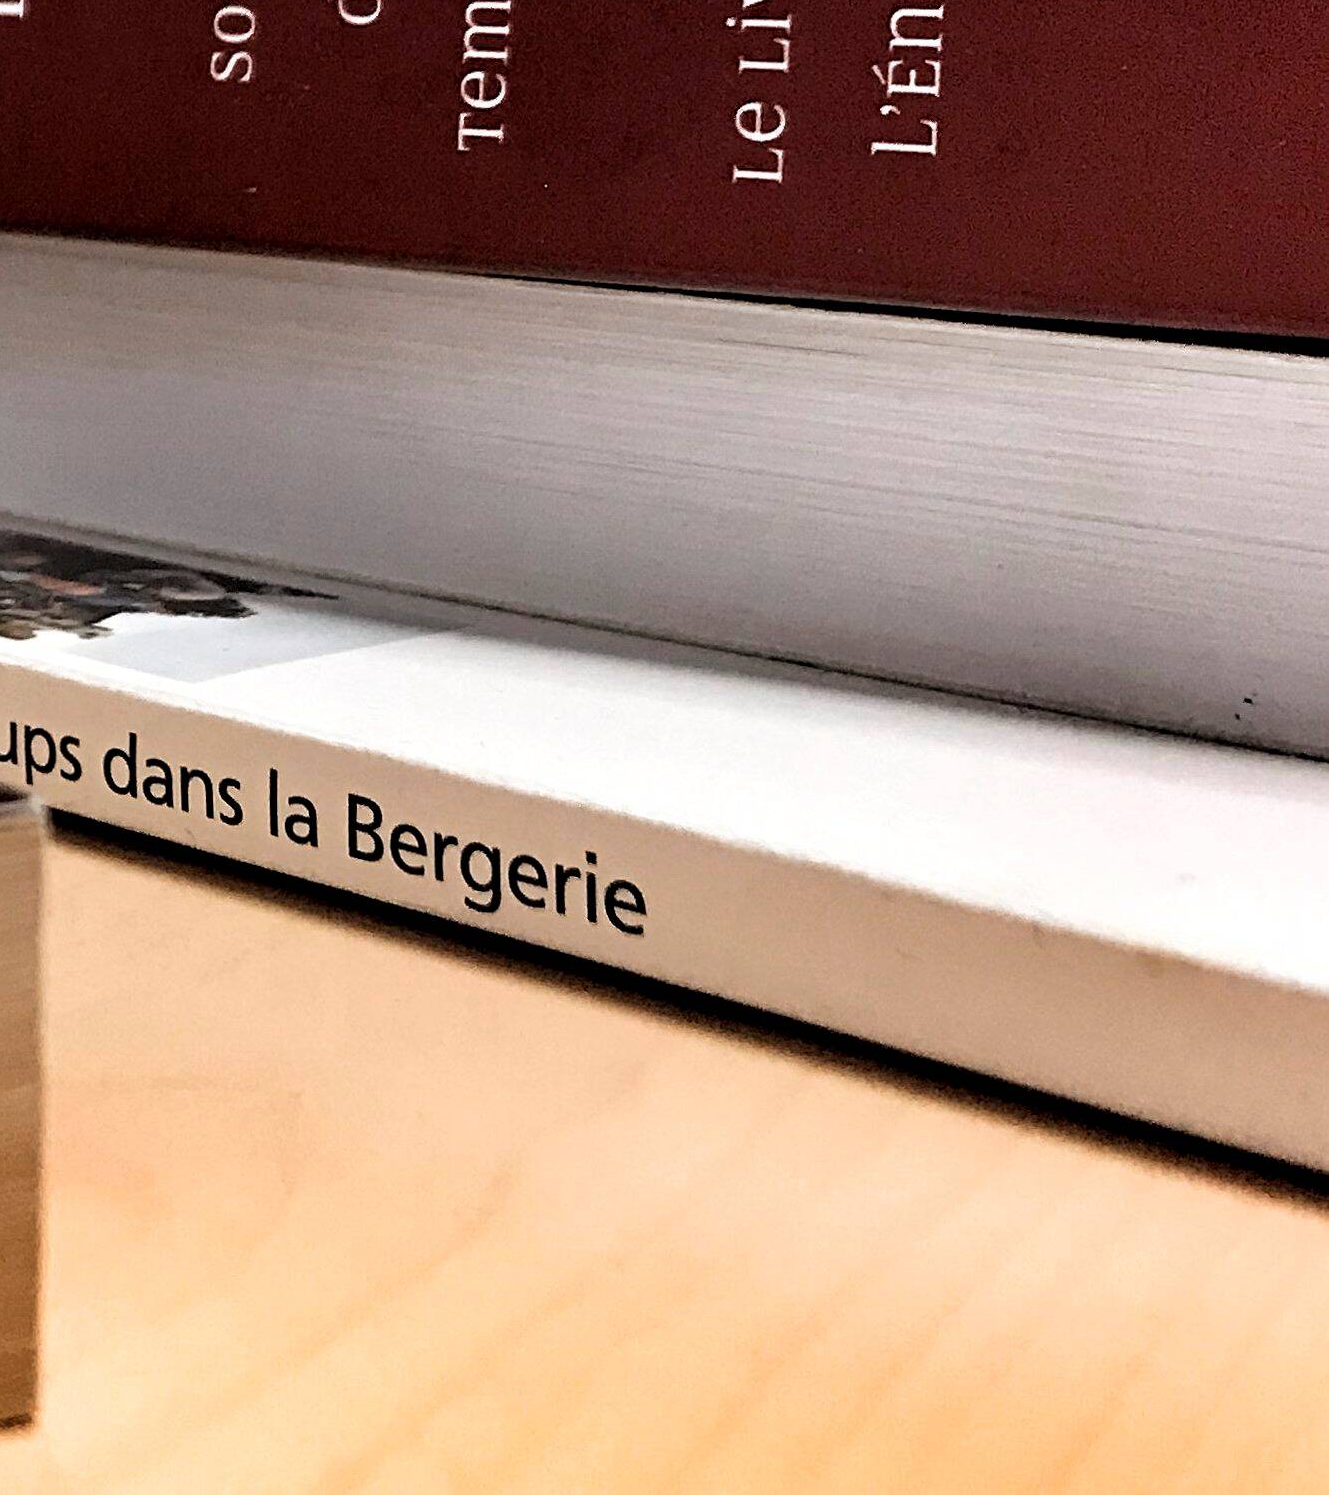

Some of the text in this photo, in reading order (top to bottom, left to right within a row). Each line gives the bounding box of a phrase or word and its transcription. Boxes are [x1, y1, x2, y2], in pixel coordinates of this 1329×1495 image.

[731, 100, 788, 185] Le
[101, 730, 245, 828] dans
[267, 766, 320, 849] la
[346, 791, 649, 937] Bergerie
